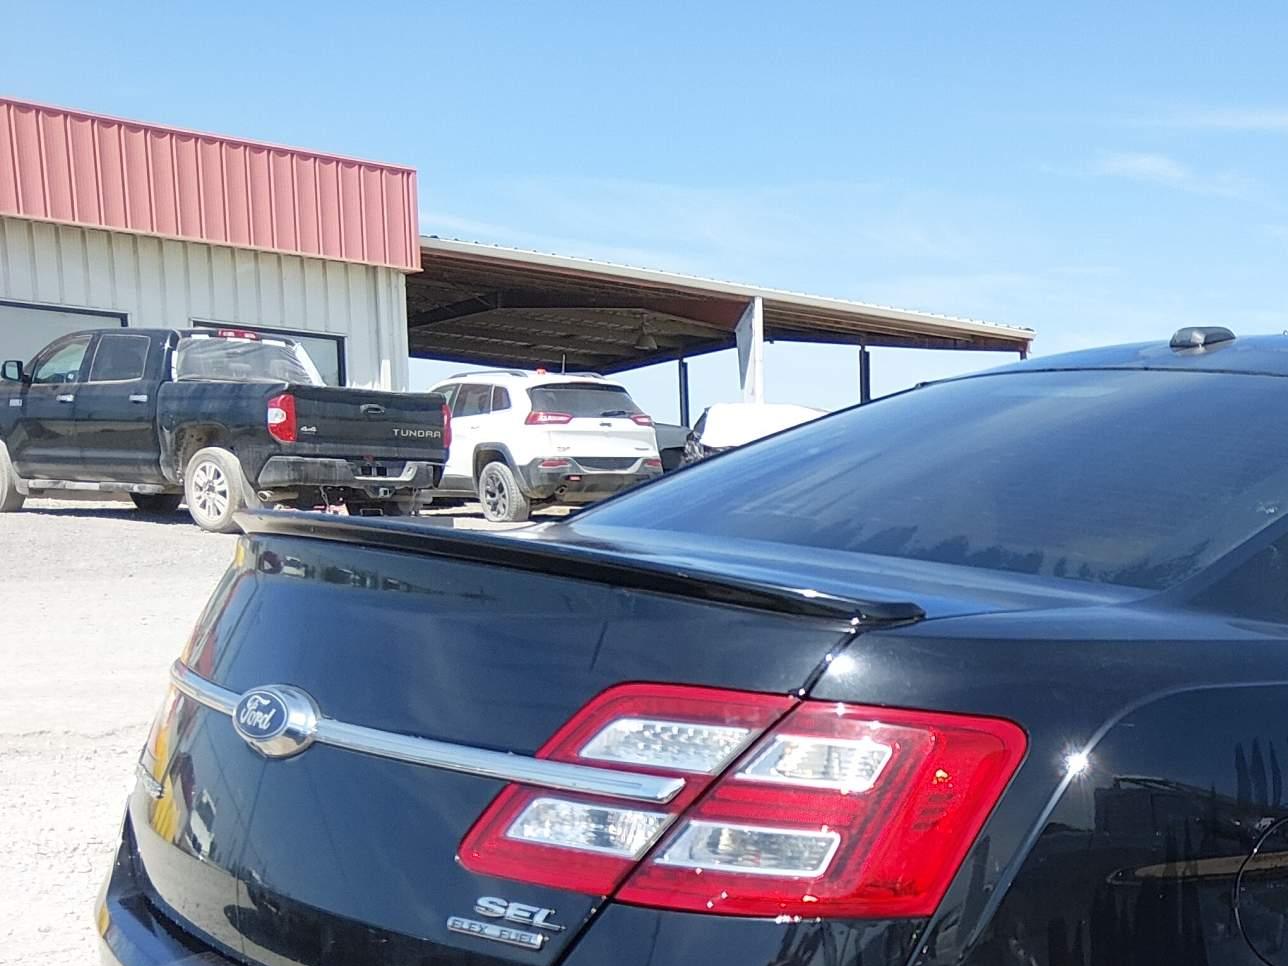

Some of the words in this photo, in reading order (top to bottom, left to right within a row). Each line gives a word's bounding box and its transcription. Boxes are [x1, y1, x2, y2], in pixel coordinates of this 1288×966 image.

[392, 428, 441, 439] TUNDRA
[240, 695, 276, 730] Ford
[474, 896, 562, 930] SEL
[451, 918, 488, 934] FLEX
[499, 929, 540, 945] FUEL
